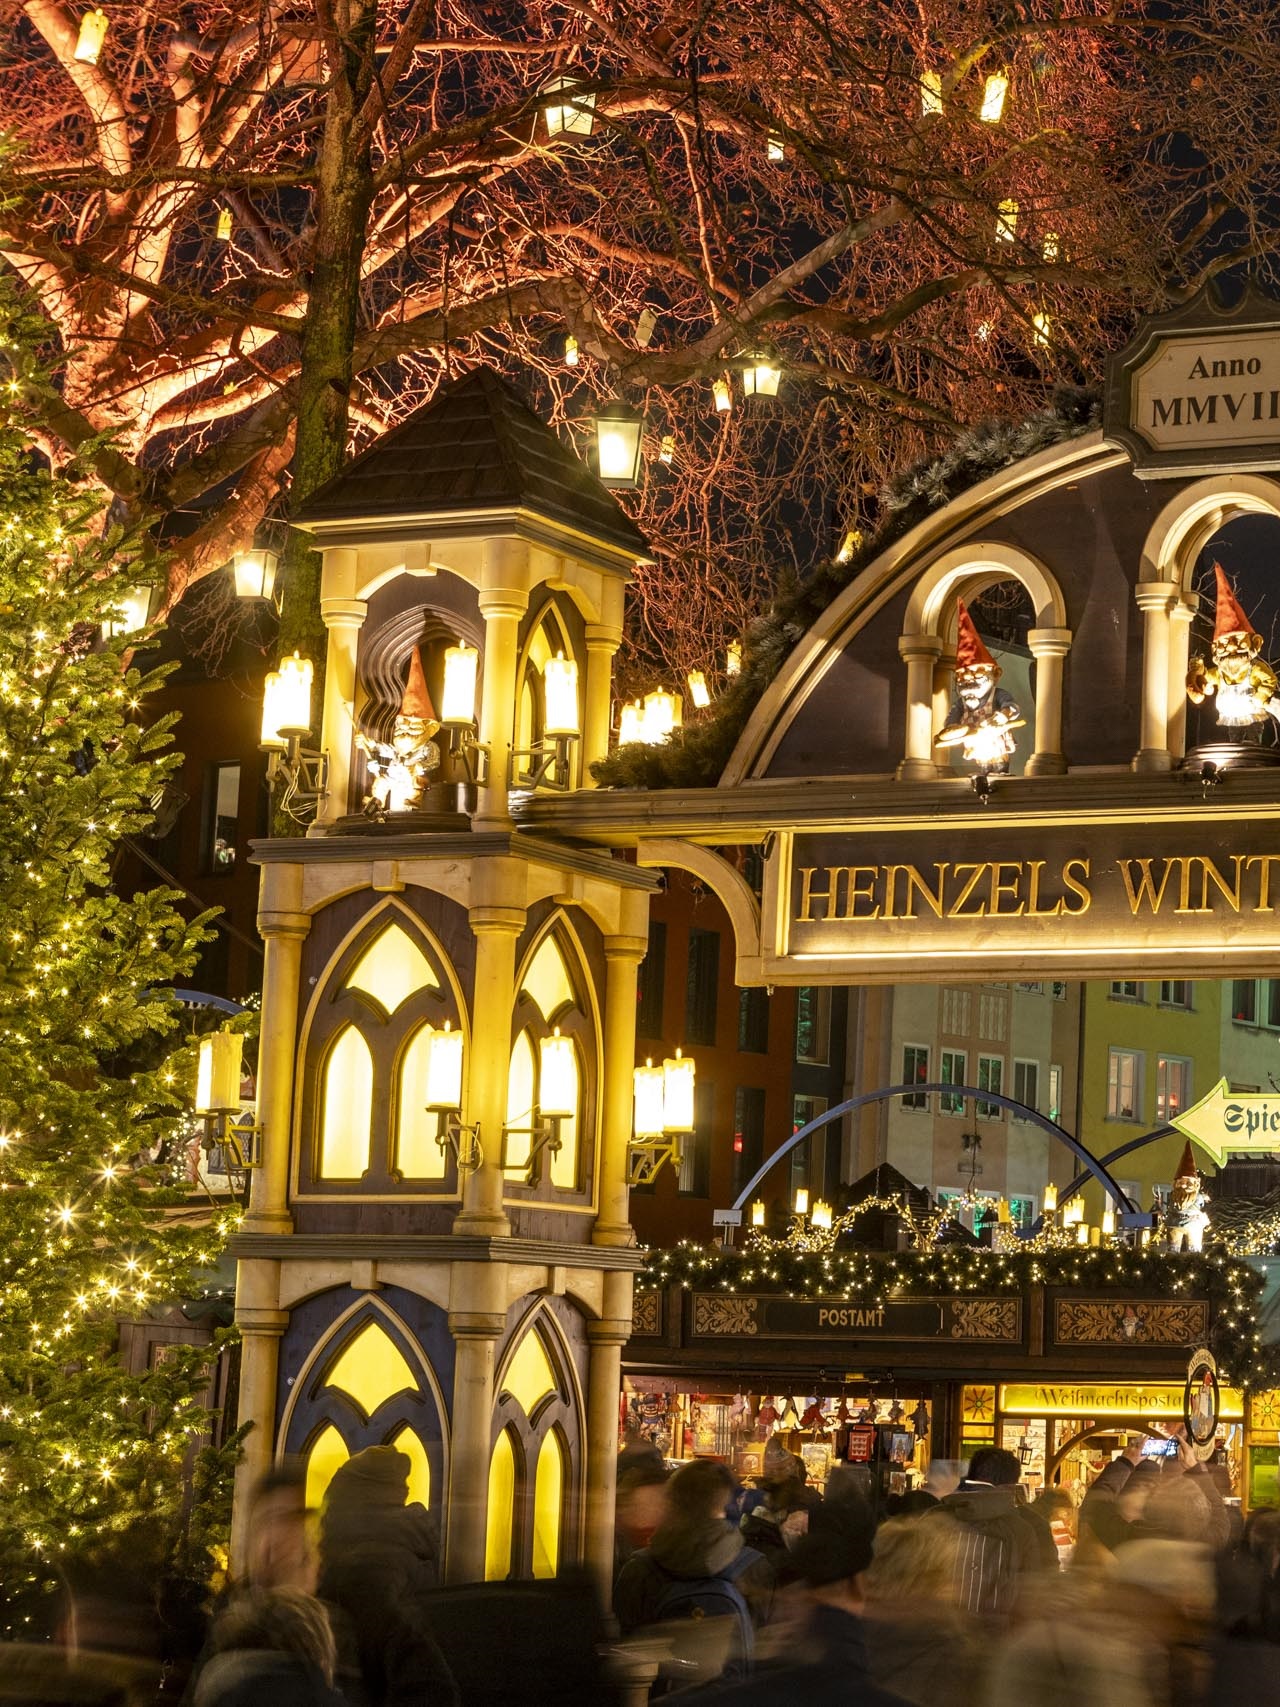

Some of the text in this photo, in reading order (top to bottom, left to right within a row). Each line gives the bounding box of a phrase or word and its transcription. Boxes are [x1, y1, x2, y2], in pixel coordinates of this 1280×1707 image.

[1188, 355, 1262, 380] Anno
[795, 858, 1092, 922] HEINZELS
[818, 1308, 885, 1327] POSTAMT
[1035, 1388, 1186, 1412] Weihnachtsposta
